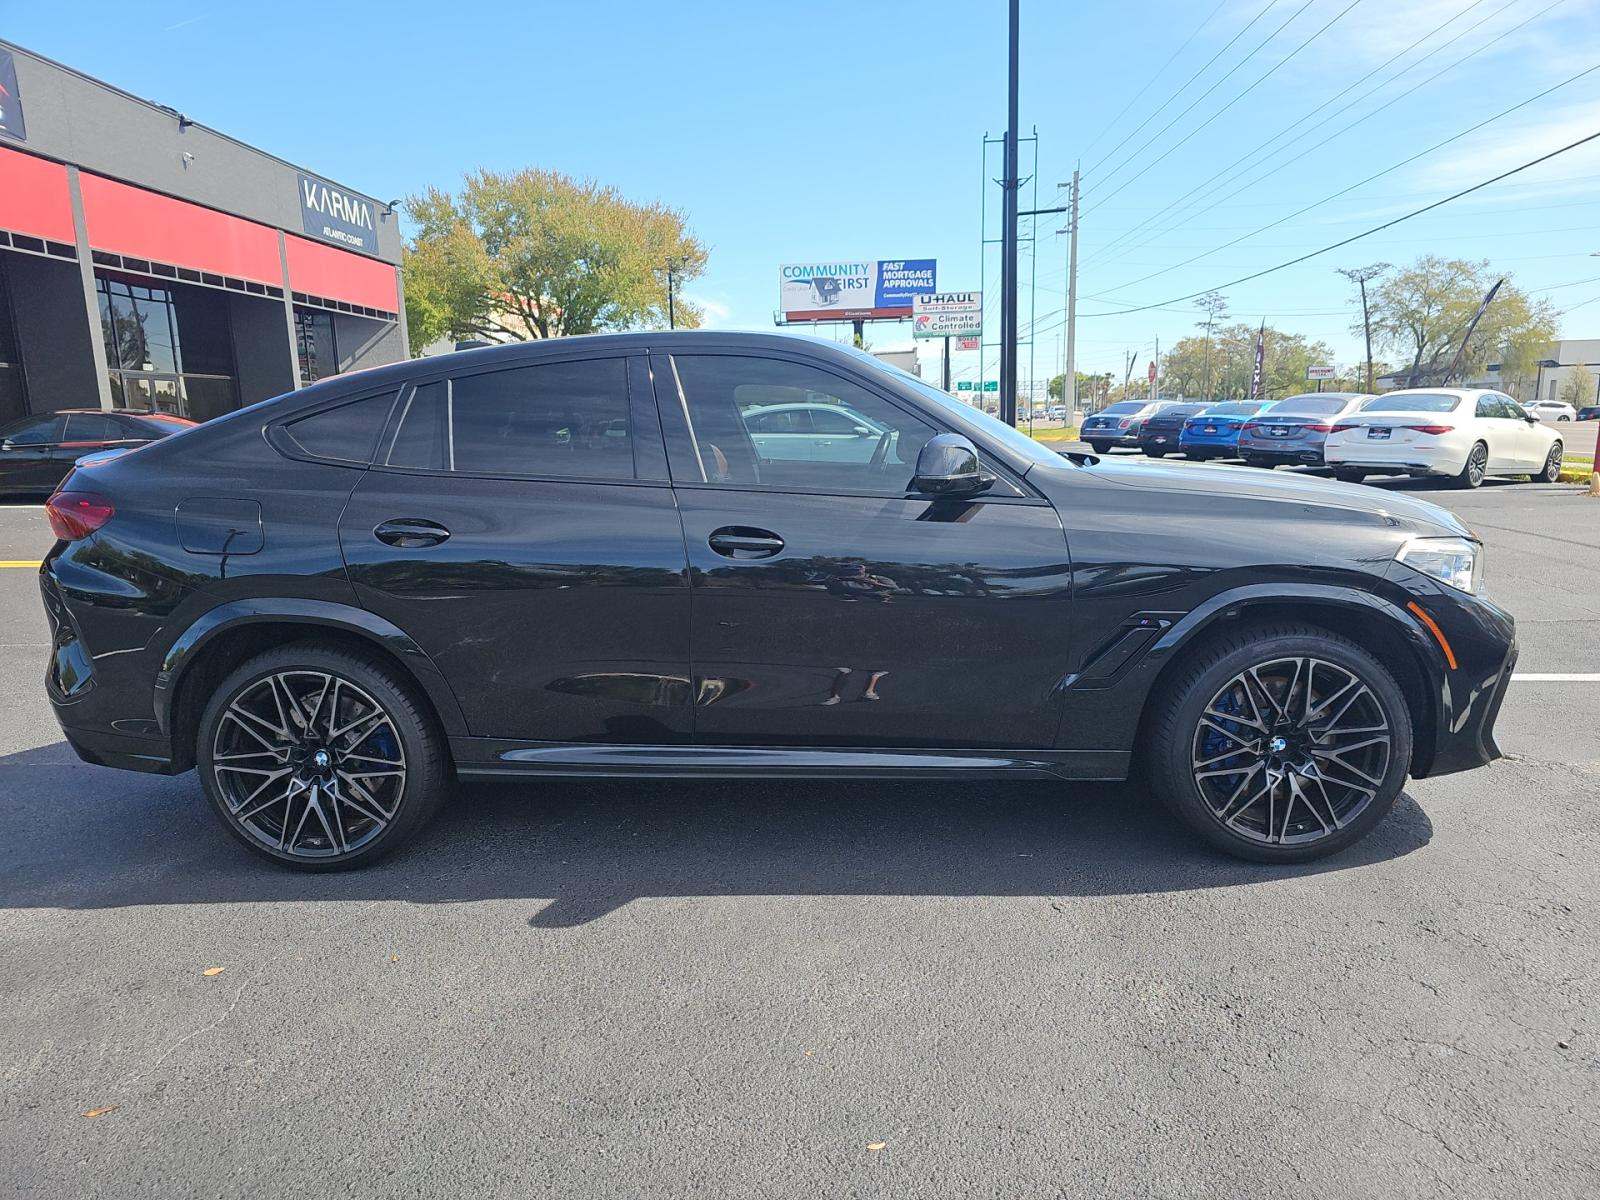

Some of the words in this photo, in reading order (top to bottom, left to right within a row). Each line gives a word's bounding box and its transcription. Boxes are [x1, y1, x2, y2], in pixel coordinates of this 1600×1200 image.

[304, 180, 372, 230] KARMA
[783, 264, 869, 278] COMMUNITY
[883, 262, 905, 270] FAST
[883, 270, 933, 280] MORTGAGE
[837, 278, 869, 289] FIRST
[883, 279, 934, 288] APPROVALS
[931, 321, 981, 330] Controlled
